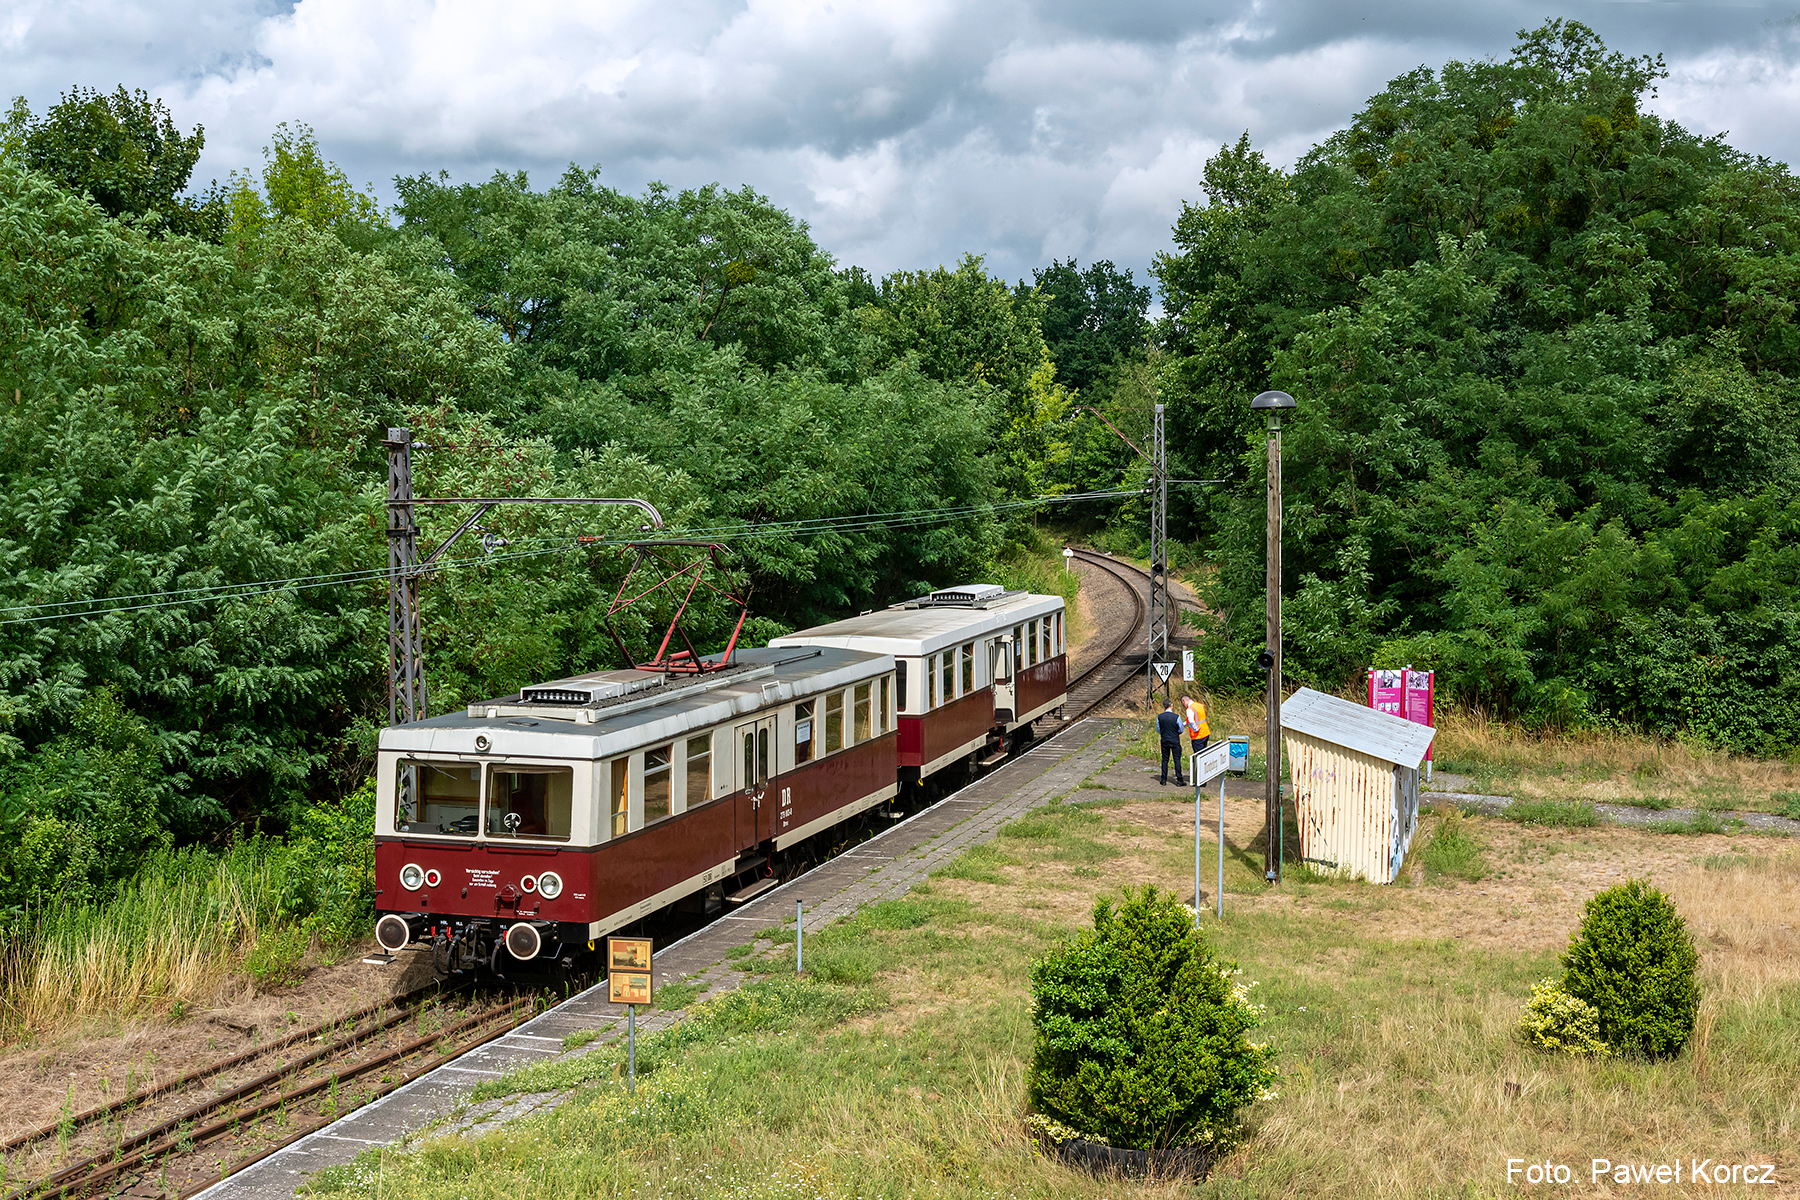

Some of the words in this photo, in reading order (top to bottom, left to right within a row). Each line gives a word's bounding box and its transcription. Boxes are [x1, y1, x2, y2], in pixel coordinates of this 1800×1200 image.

[1160, 664, 1169, 676] 20
[1186, 669, 1192, 679] 3
[781, 786, 792, 807] DR
